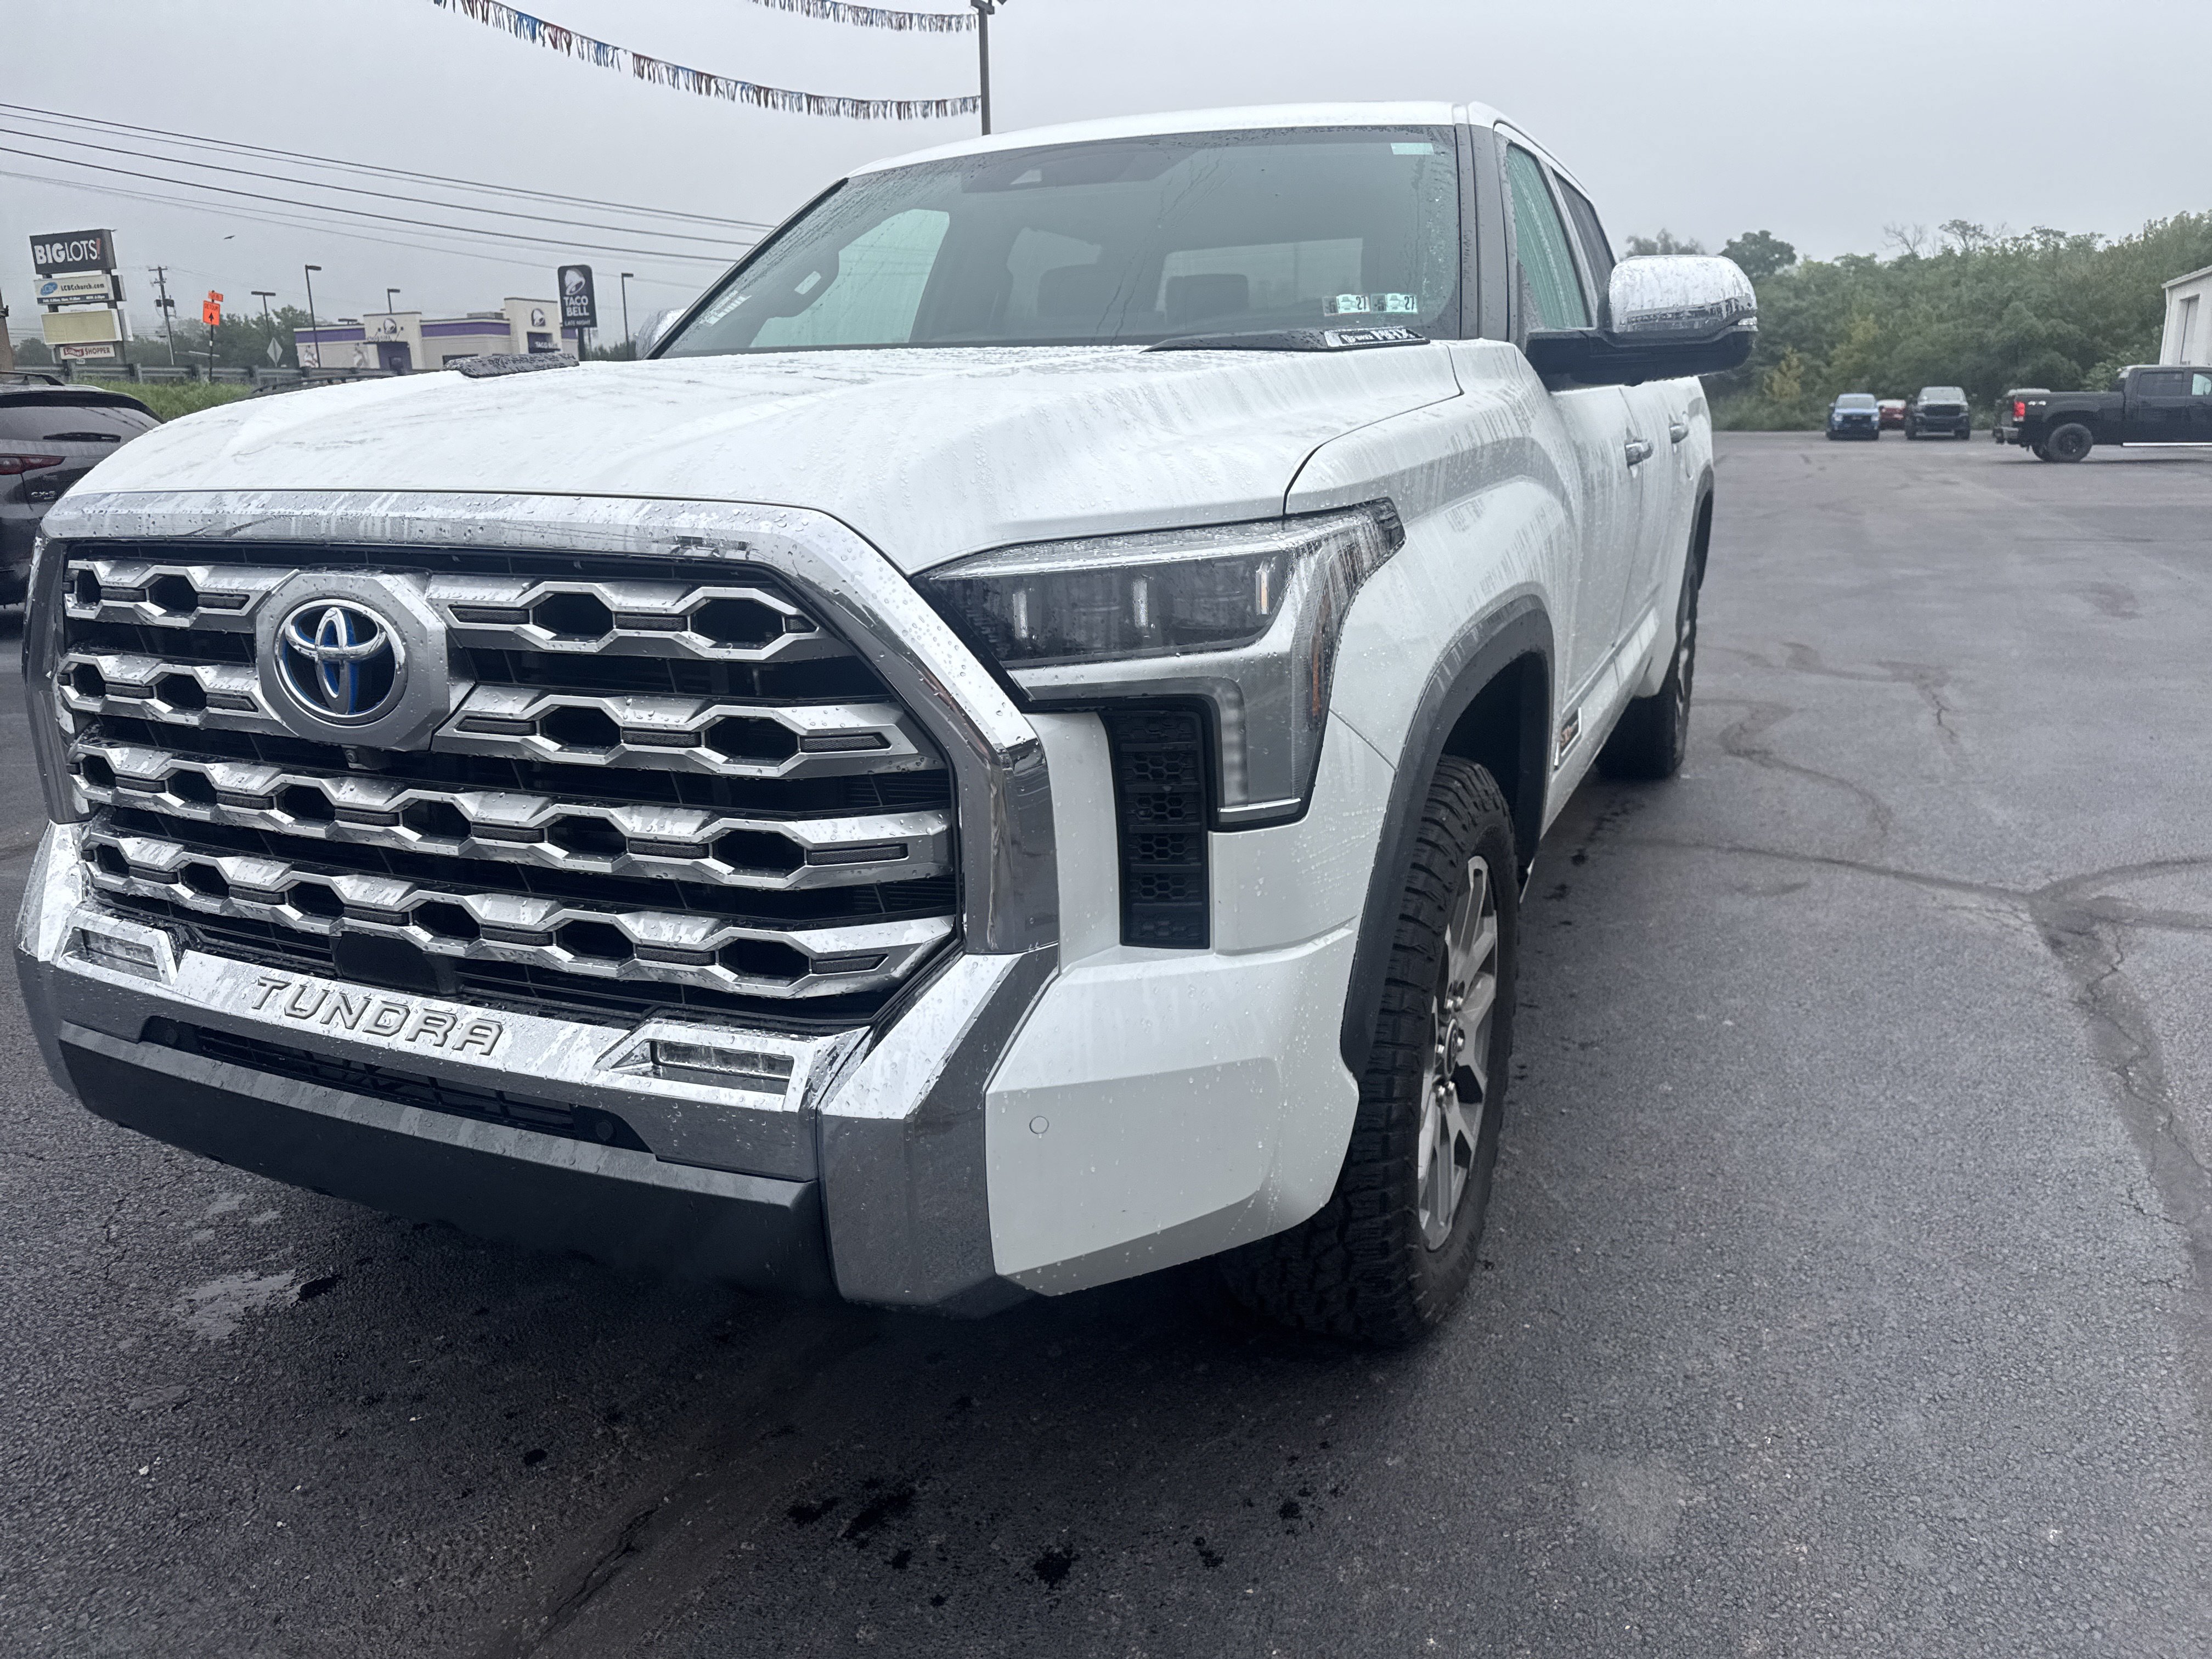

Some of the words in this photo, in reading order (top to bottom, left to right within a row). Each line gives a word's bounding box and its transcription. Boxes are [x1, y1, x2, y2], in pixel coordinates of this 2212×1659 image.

[563, 295, 589, 307] TACO
[1356, 296, 1367, 311] 27
[1404, 296, 1415, 311] 27
[566, 306, 590, 317] BELL
[251, 975, 504, 1056] TUNDRA
